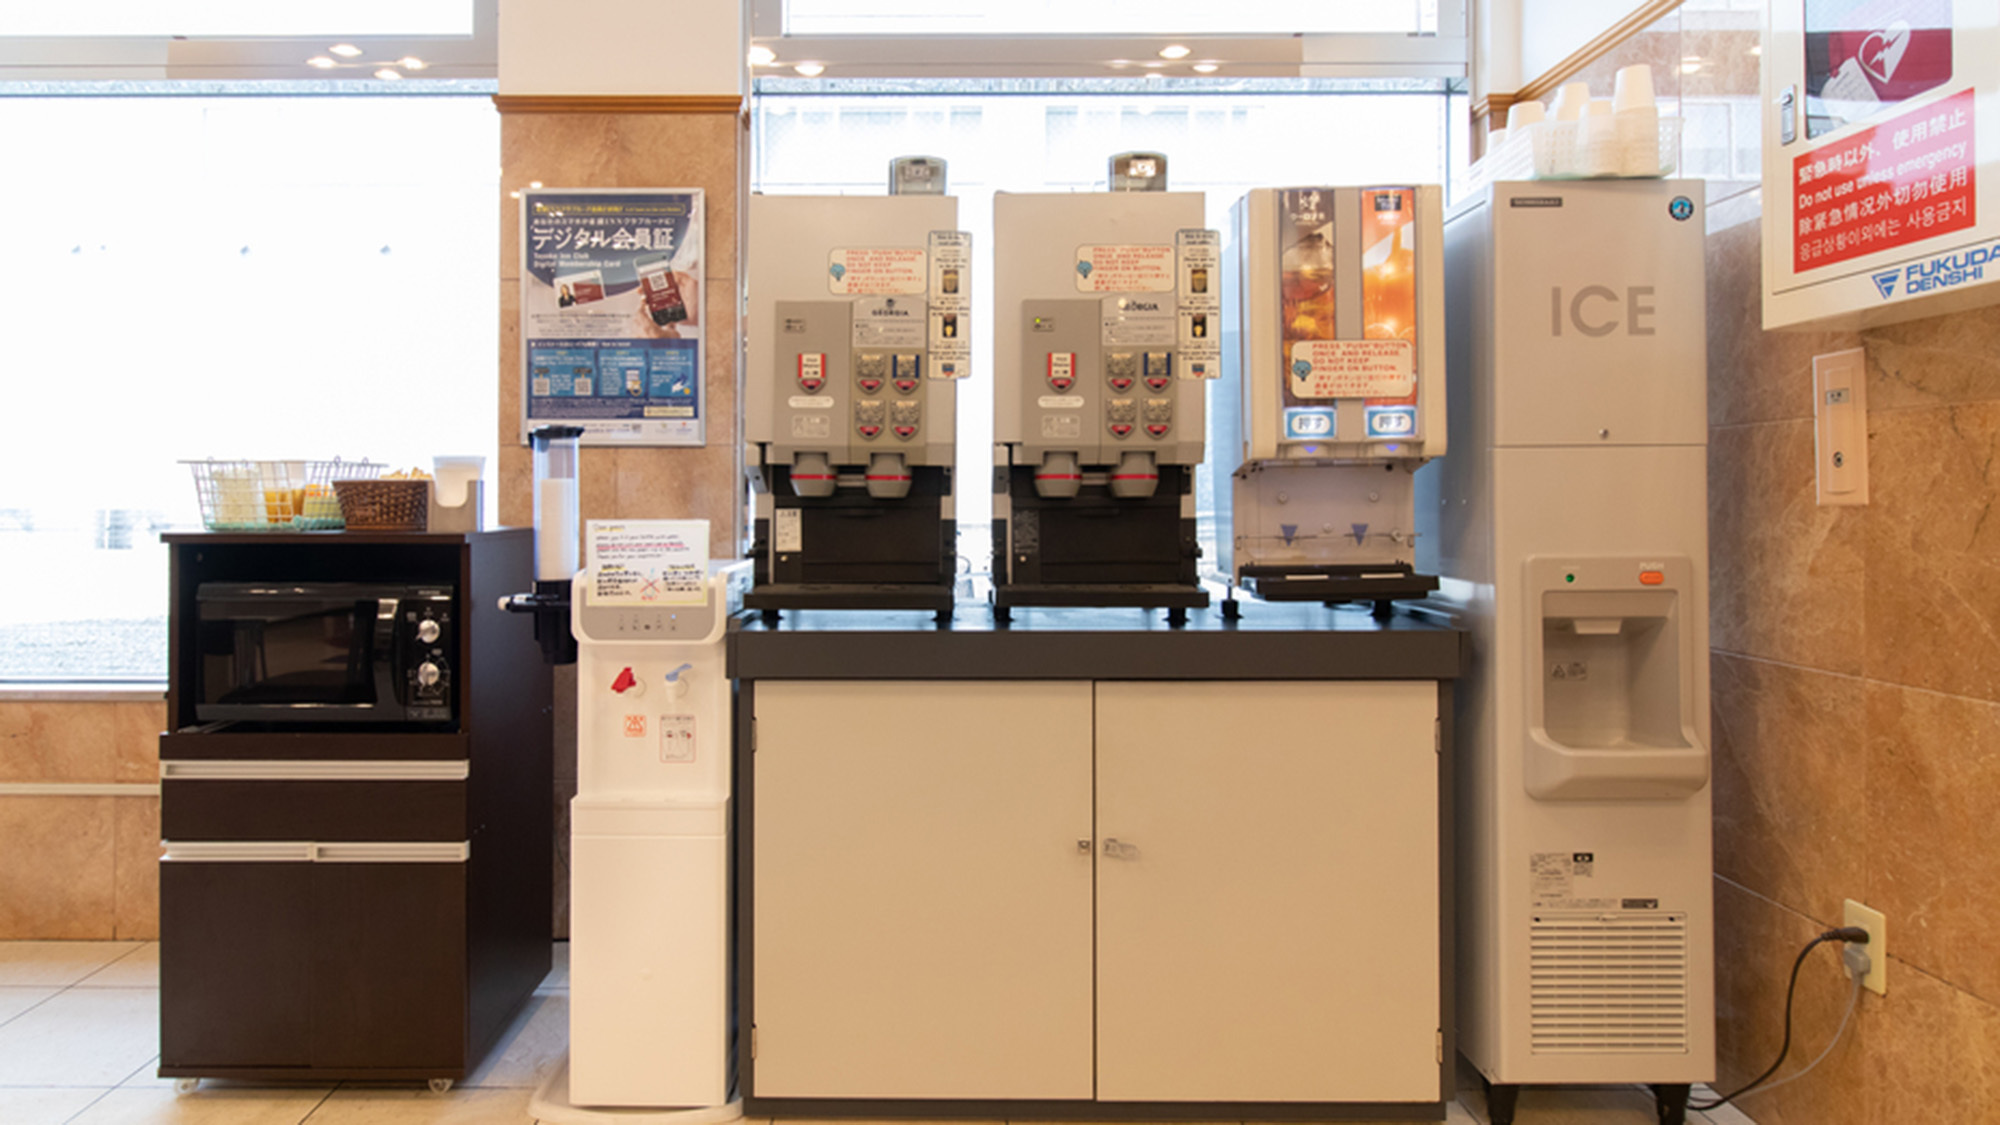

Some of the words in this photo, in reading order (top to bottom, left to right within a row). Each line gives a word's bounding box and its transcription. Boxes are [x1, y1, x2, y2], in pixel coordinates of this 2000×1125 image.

[1799, 193, 1813, 210] Do
[1815, 186, 1832, 204] not
[1834, 180, 1854, 197] use
[1856, 166, 1894, 191] unless
[1896, 140, 1967, 176] emergency
[1906, 195, 1967, 229] 사용금지
[532, 227, 675, 250] デジタル会員証
[1906, 243, 2000, 282] FUKUDA
[1906, 265, 1984, 295] DENSHI
[871, 309, 910, 317] GEORGIA
[1551, 284, 1656, 337] ICE
[1639, 561, 1665, 571] PUSH
